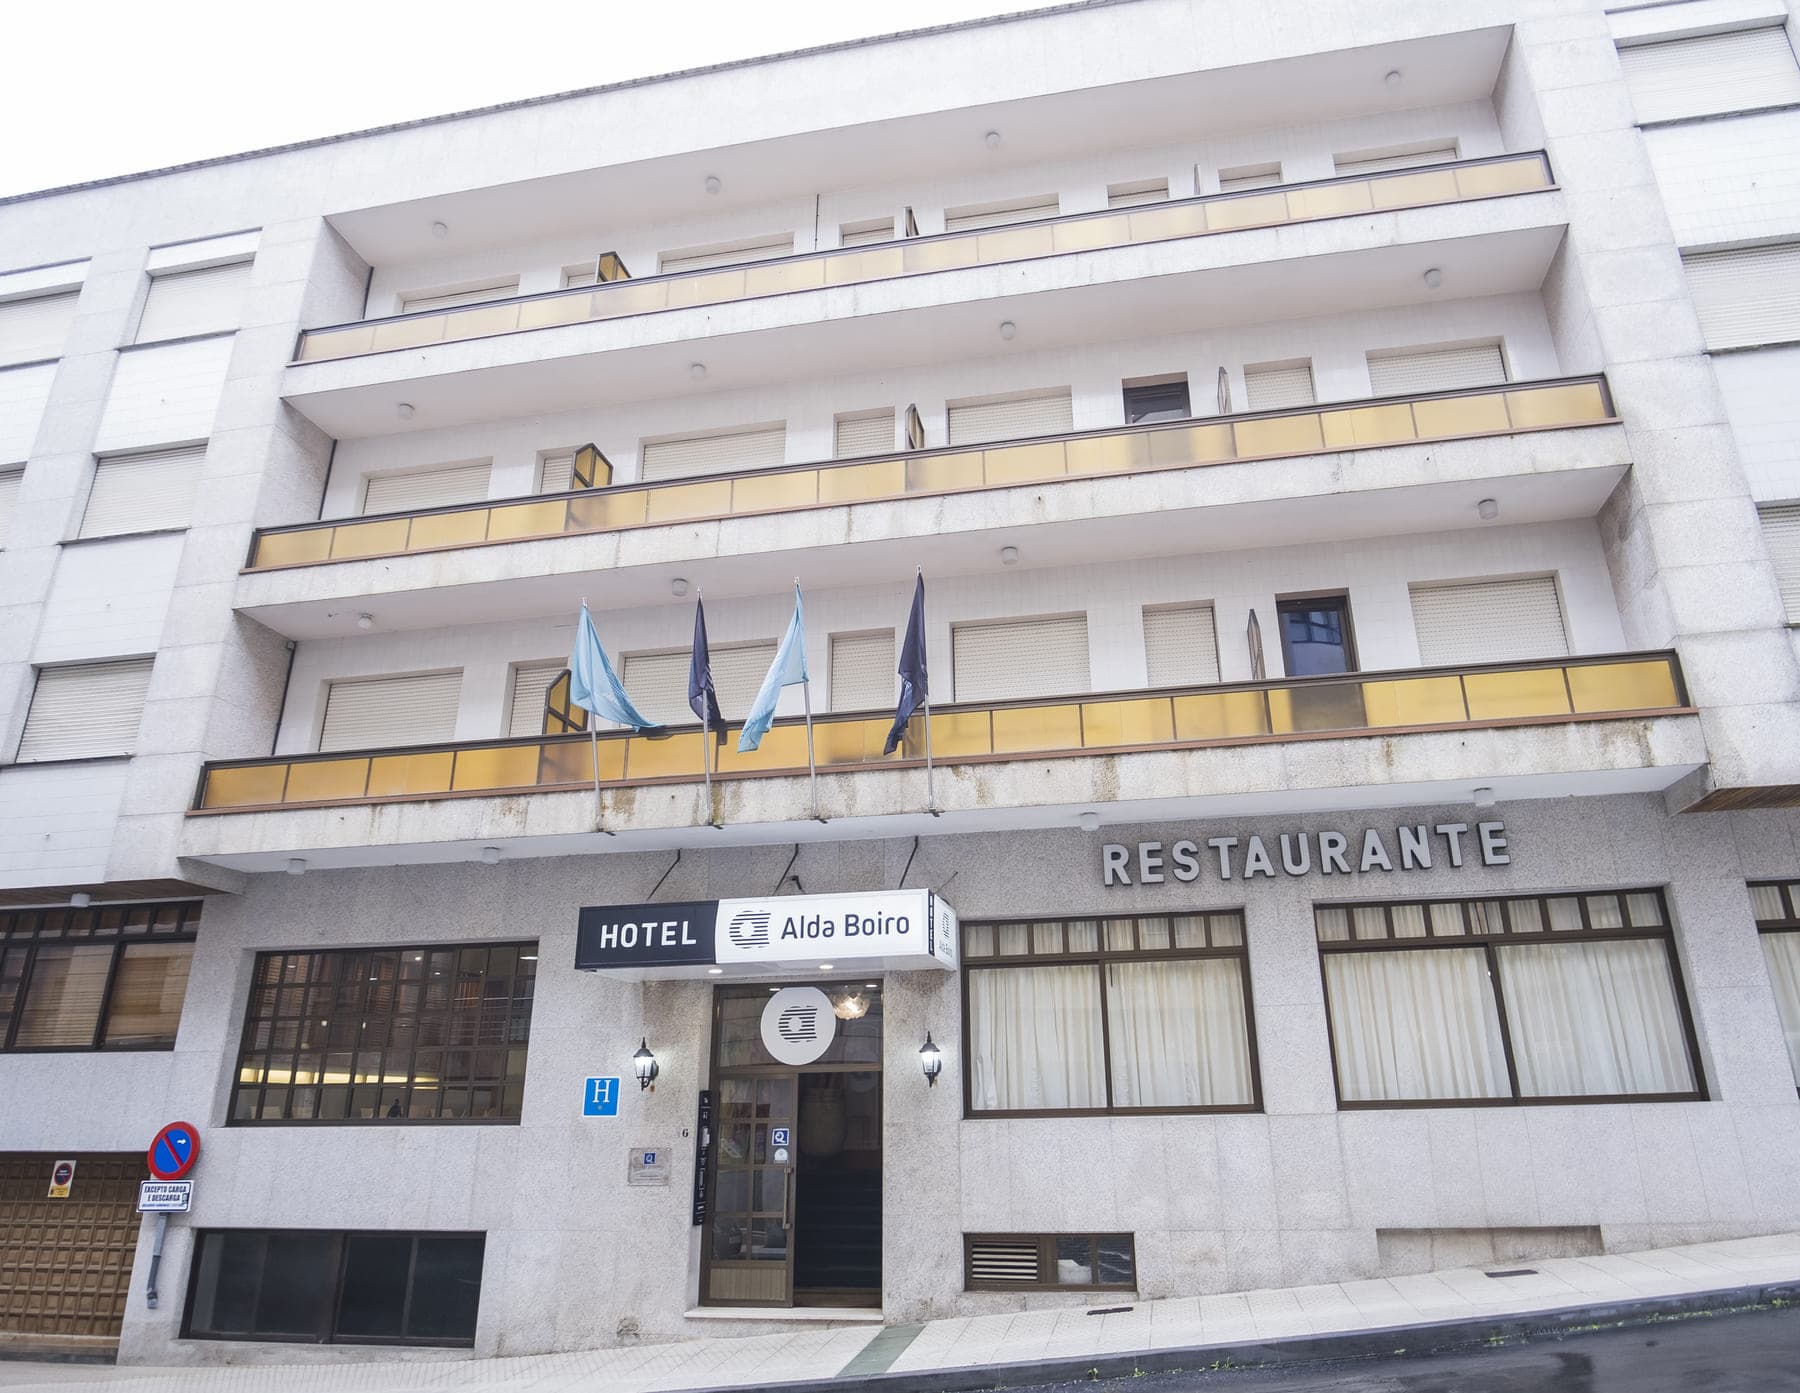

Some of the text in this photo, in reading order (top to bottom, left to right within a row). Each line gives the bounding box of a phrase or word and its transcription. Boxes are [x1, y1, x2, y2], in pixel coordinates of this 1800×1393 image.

[1102, 821, 1511, 887] RESTAURANTE
[600, 921, 697, 949] HOTEL
[781, 910, 910, 940] Alda Boiro
[591, 1079, 612, 1103] H
[144, 1185, 186, 1193] EXCEPTO CARGA
